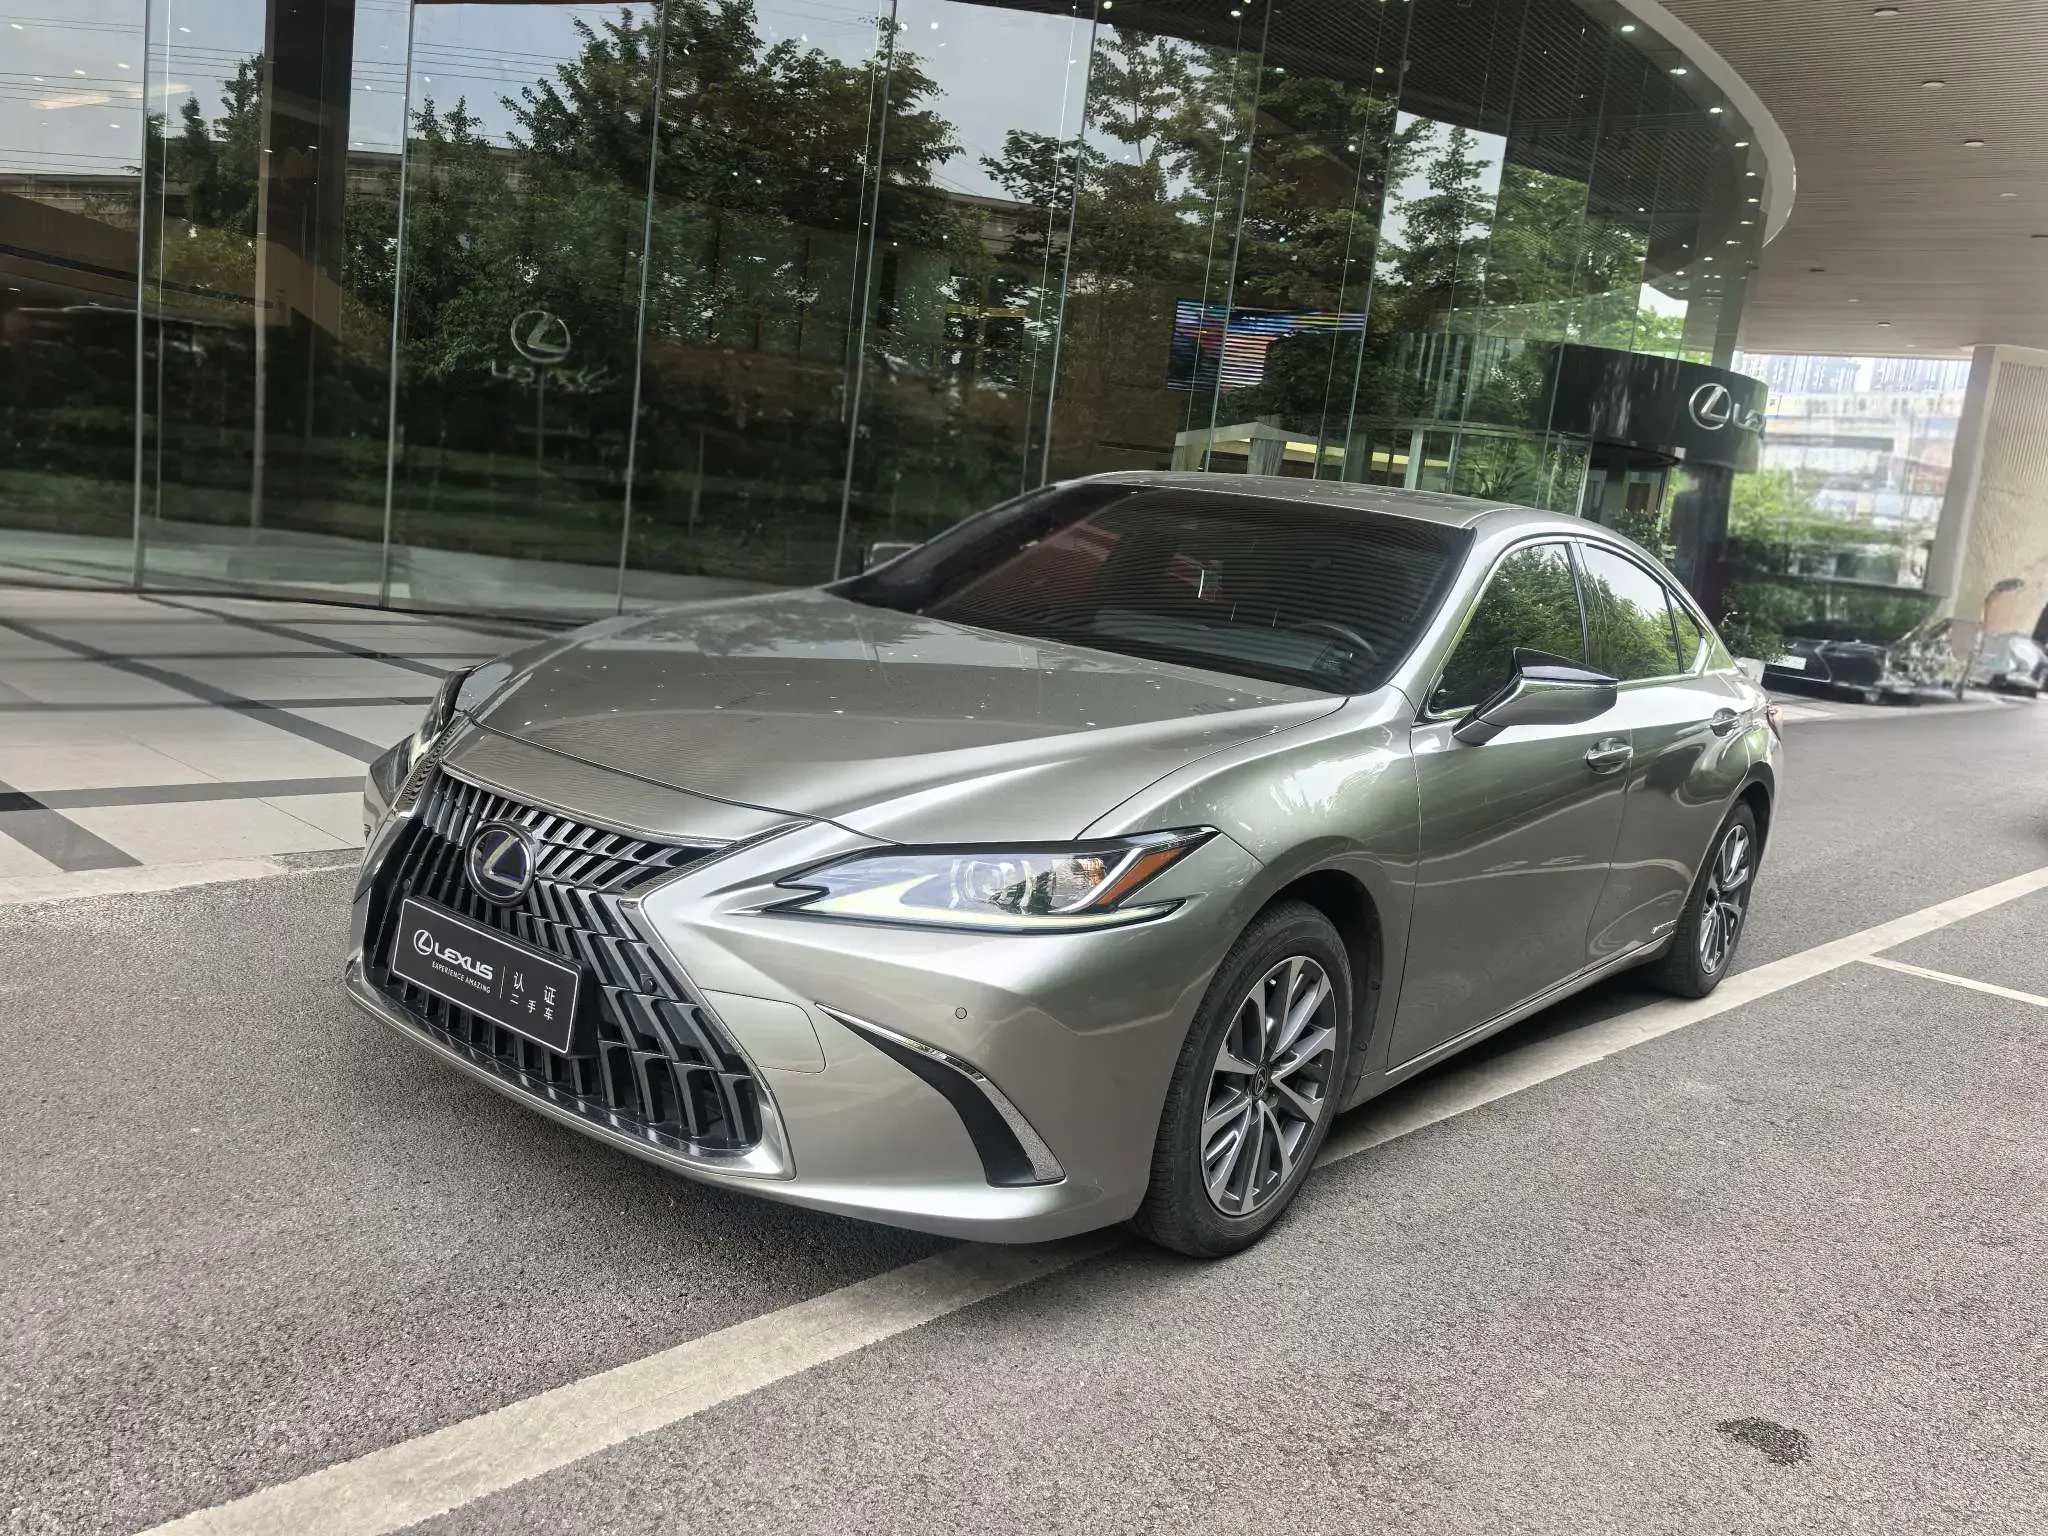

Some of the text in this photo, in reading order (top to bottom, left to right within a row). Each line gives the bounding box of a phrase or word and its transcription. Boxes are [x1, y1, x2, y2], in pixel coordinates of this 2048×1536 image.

[431, 960, 491, 994] EXPERIENCE AMAZING
[434, 942, 494, 980] LEXUS
